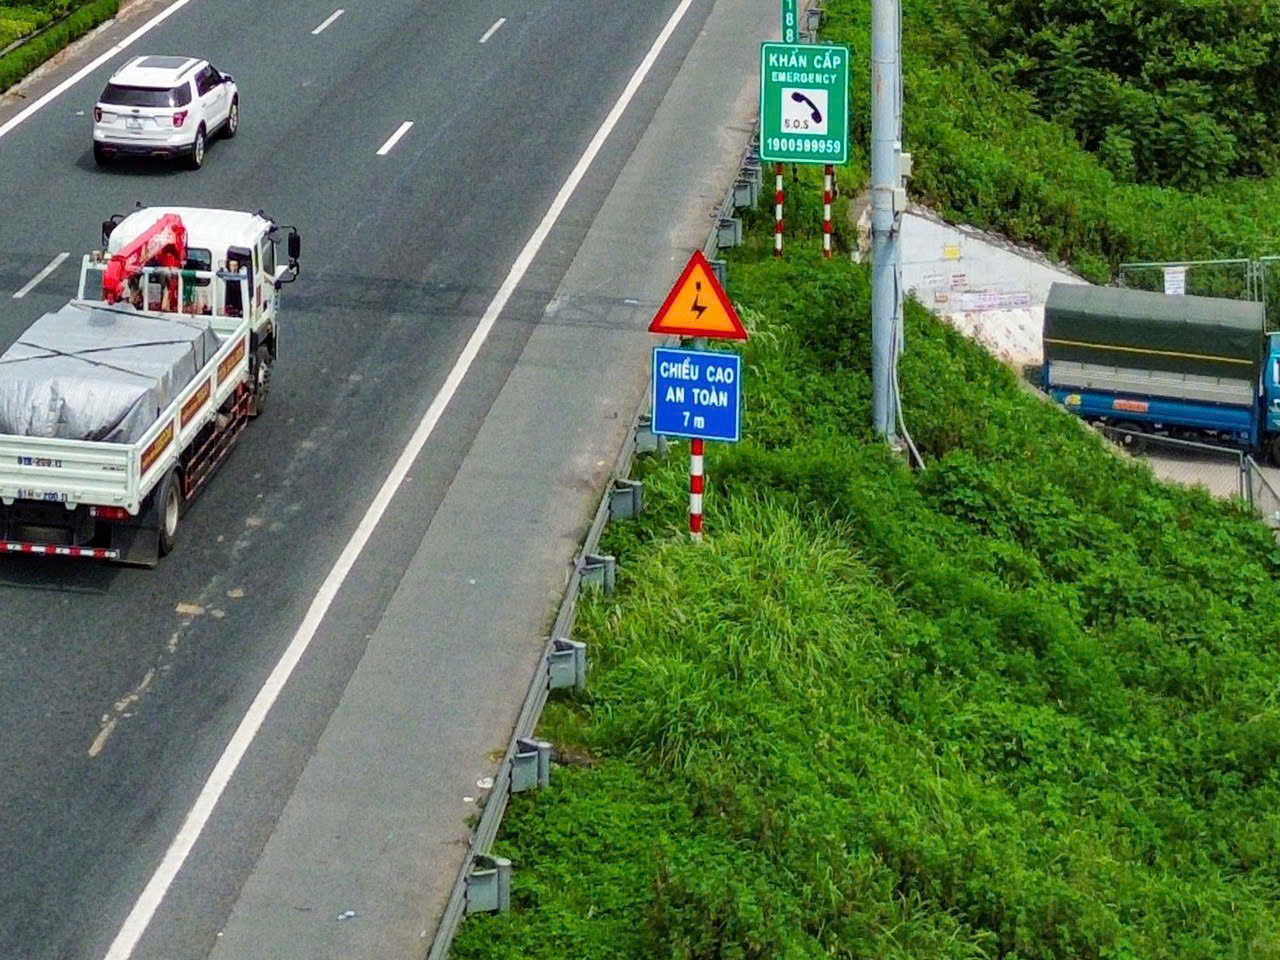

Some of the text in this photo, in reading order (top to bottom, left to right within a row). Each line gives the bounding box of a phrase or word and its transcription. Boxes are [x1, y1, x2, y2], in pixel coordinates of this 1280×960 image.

[771, 71, 838, 84] EMERGENCY
[706, 366, 734, 383] CAO
[665, 386, 728, 407] AN TOÀN
[682, 411, 705, 429] 7 m
